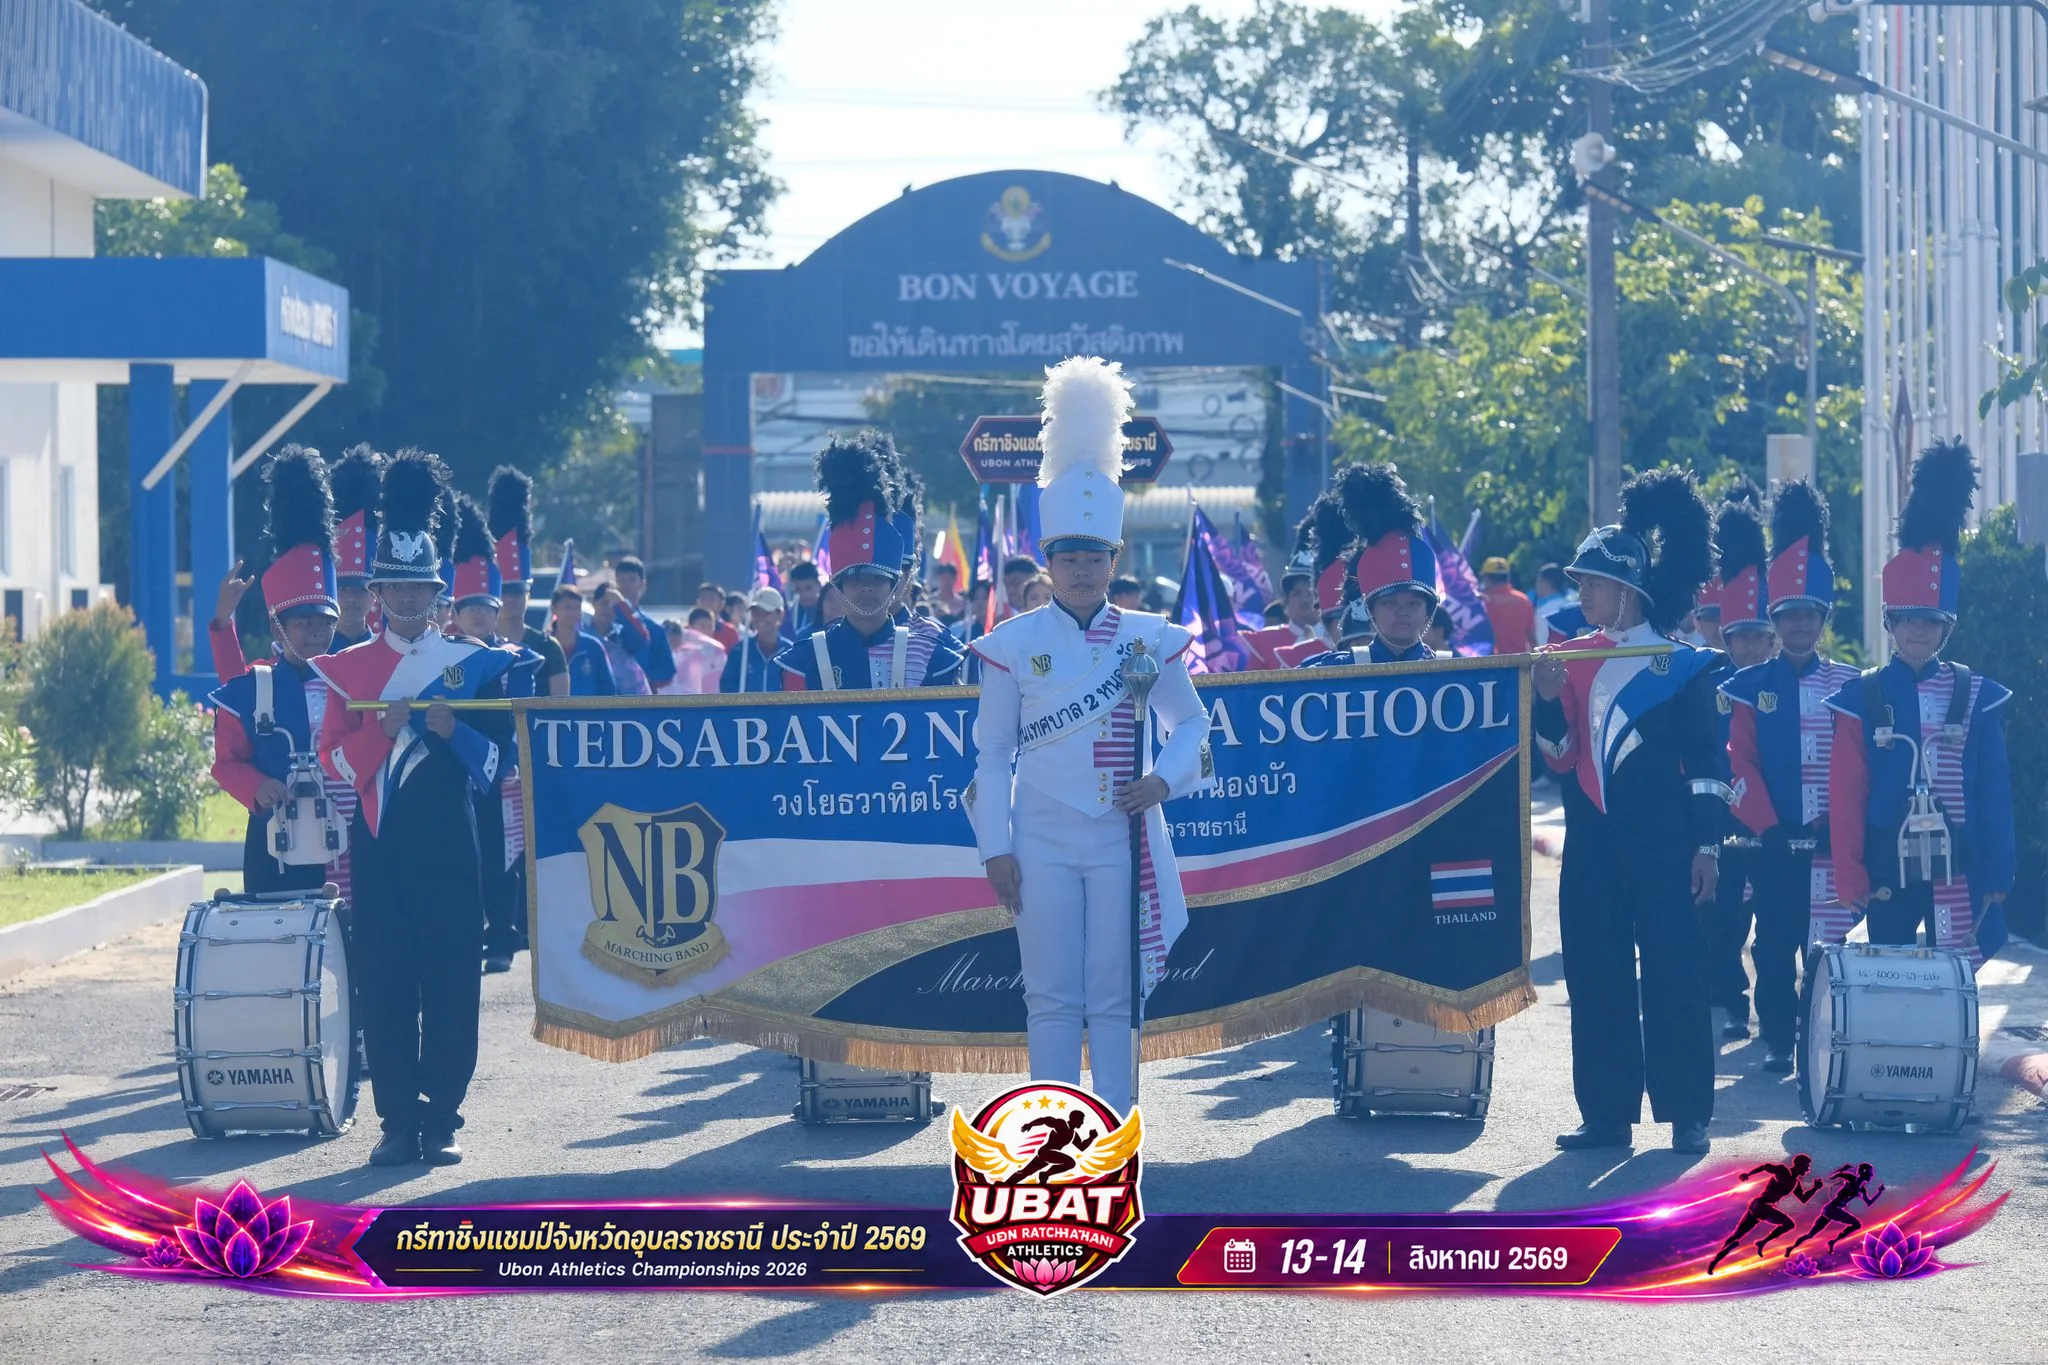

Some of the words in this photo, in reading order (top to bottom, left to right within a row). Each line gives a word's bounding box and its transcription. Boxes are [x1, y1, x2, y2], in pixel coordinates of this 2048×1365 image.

[898, 273, 977, 300] BON
[986, 271, 1138, 299] VOYAGE
[981, 459, 1010, 468] UBON
[1014, 459, 1041, 468] ATHL
[1031, 654, 1051, 672] NB
[445, 666, 464, 685] NB
[534, 714, 862, 768] TEDSABAN
[881, 711, 908, 761] 2
[925, 709, 979, 759] N
[1259, 681, 1510, 746] SCHOOL
[1019, 701, 1084, 745] นเทศบาล
[1083, 693, 1100, 712] 2
[772, 775, 960, 816] วงโยธวาทิตโร
[594, 820, 710, 926] NB
[1434, 912, 1497, 925] THAILAND
[604, 940, 673, 963] MARCHING
[675, 941, 710, 961] BAND
[917, 951, 1024, 994] March
[1159, 948, 1215, 983] nd
[227, 1068, 295, 1085] YAMAHA
[1886, 1065, 1934, 1079] YAMAHA
[844, 1096, 910, 1109] YAMAHA
